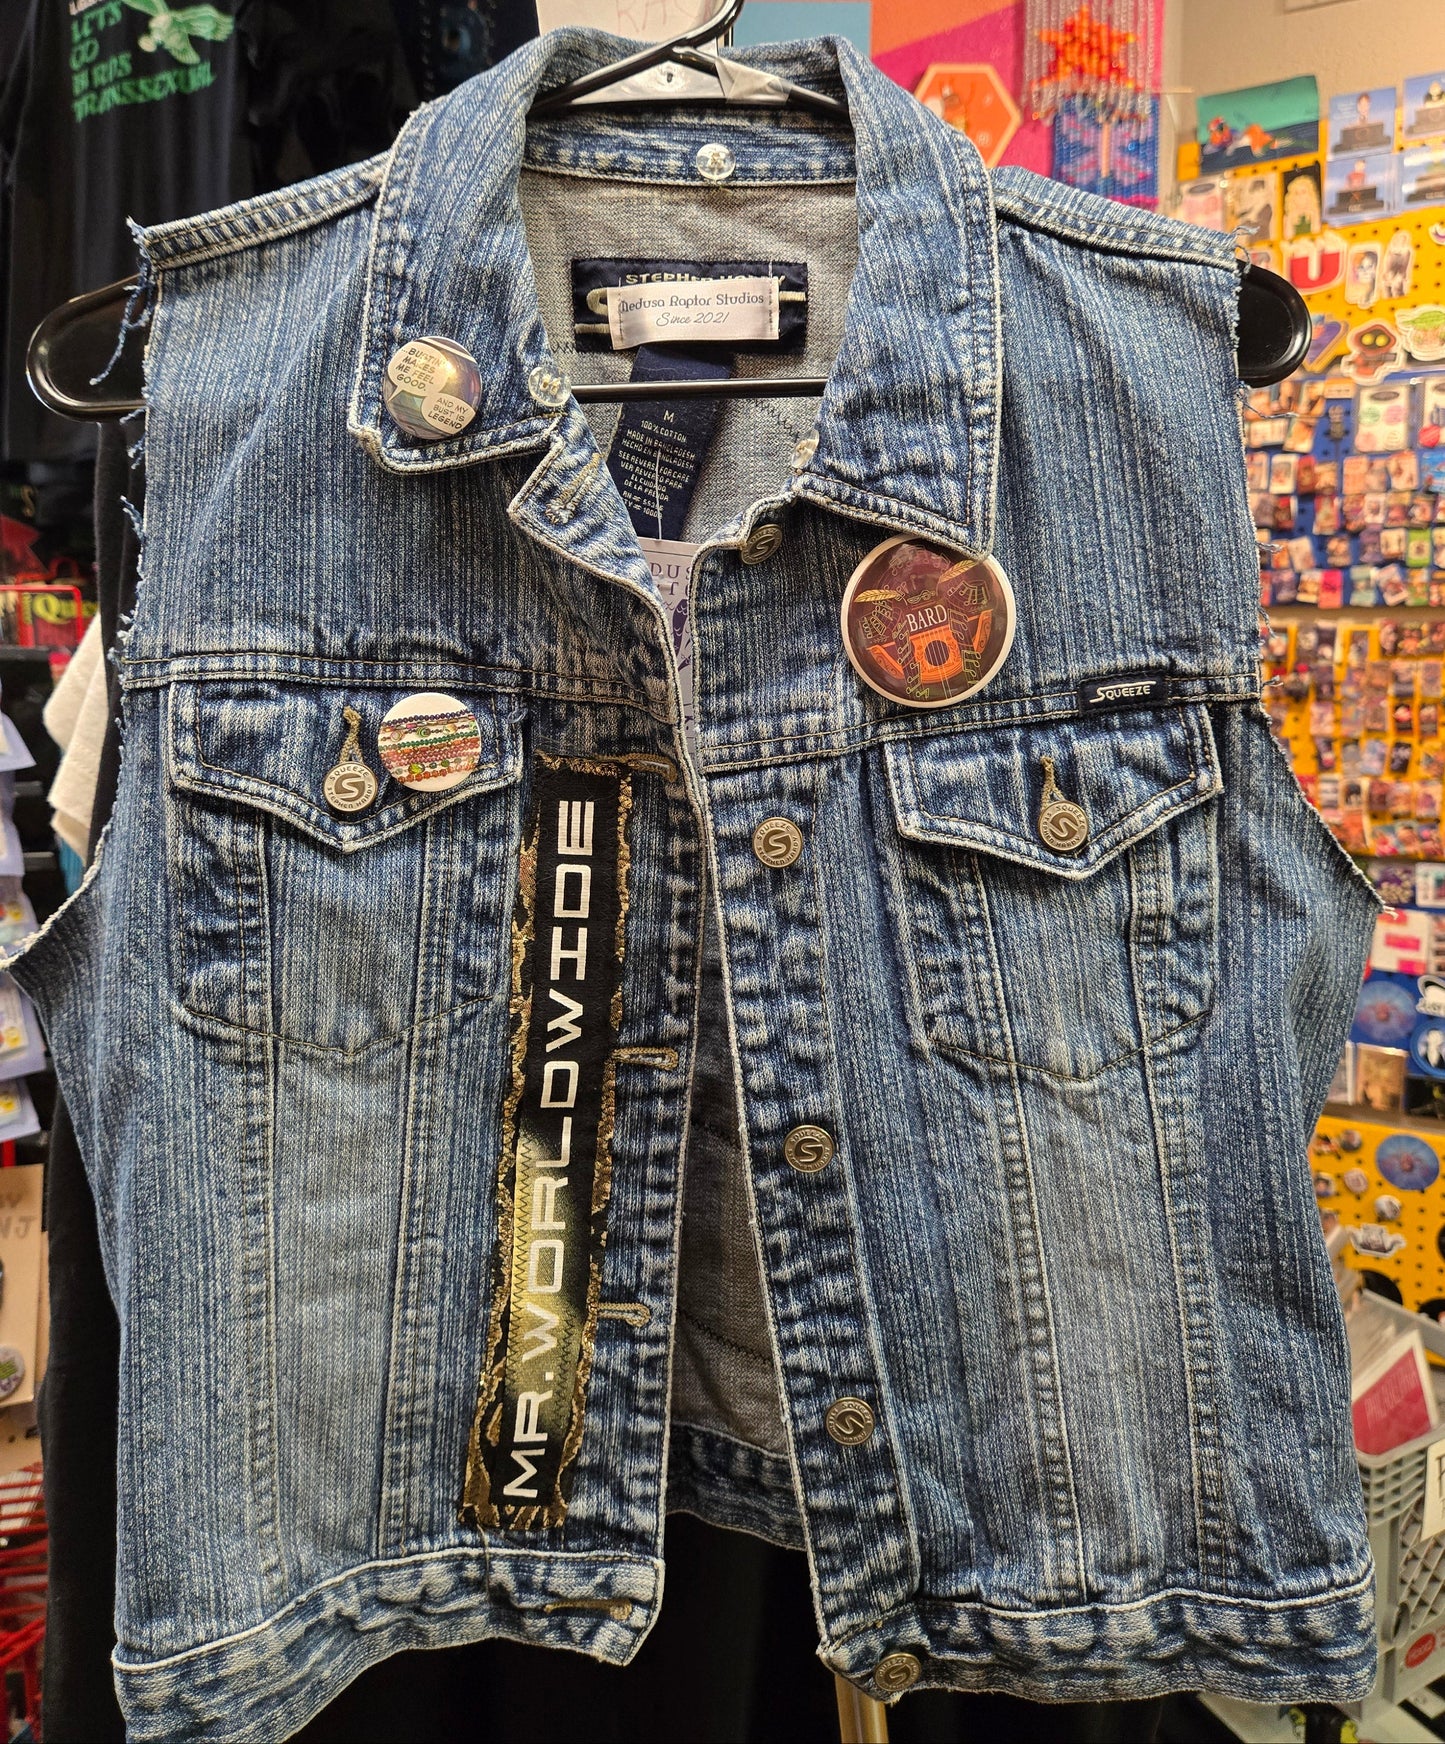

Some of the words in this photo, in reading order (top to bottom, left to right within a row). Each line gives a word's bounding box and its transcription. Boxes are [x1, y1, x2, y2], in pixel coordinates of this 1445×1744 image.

[618, 298, 665, 313] Medusa
[670, 294, 712, 308] Raptor
[716, 292, 764, 305] Studios
[656, 312, 691, 326] Since
[693, 312, 730, 323] 2021
[396, 364, 410, 373] ME
[411, 370, 434, 385] FEEL
[397, 374, 426, 391] GOOD.
[433, 404, 454, 416] BUST
[456, 414, 465, 422] IS
[437, 397, 454, 408] AND
[455, 405, 469, 414] MY
[428, 411, 462, 429] LEGEND
[663, 410, 674, 423] M
[627, 429, 644, 442] MADE
[645, 436, 653, 445] IN
[641, 420, 659, 433] 100%
[660, 427, 687, 442] COTTON
[622, 438, 642, 451] HECHO
[643, 447, 651, 455] EN
[618, 450, 630, 460] SEE
[631, 455, 658, 471] REVERS
[659, 466, 672, 477] FOR
[673, 471, 690, 483] CARE
[621, 461, 634, 472] VER
[665, 478, 683, 489] PARA
[631, 473, 638, 481] EL
[623, 490, 632, 499] RN
[624, 479, 632, 487] DE
[644, 488, 669, 501] PREDA
[906, 604, 947, 632] BARD
[1089, 681, 1157, 703] SQUEEZE
[329, 766, 369, 780] SQUEEZE
[1055, 804, 1086, 830] SQUEEZE
[757, 822, 792, 840] SQUEEZE
